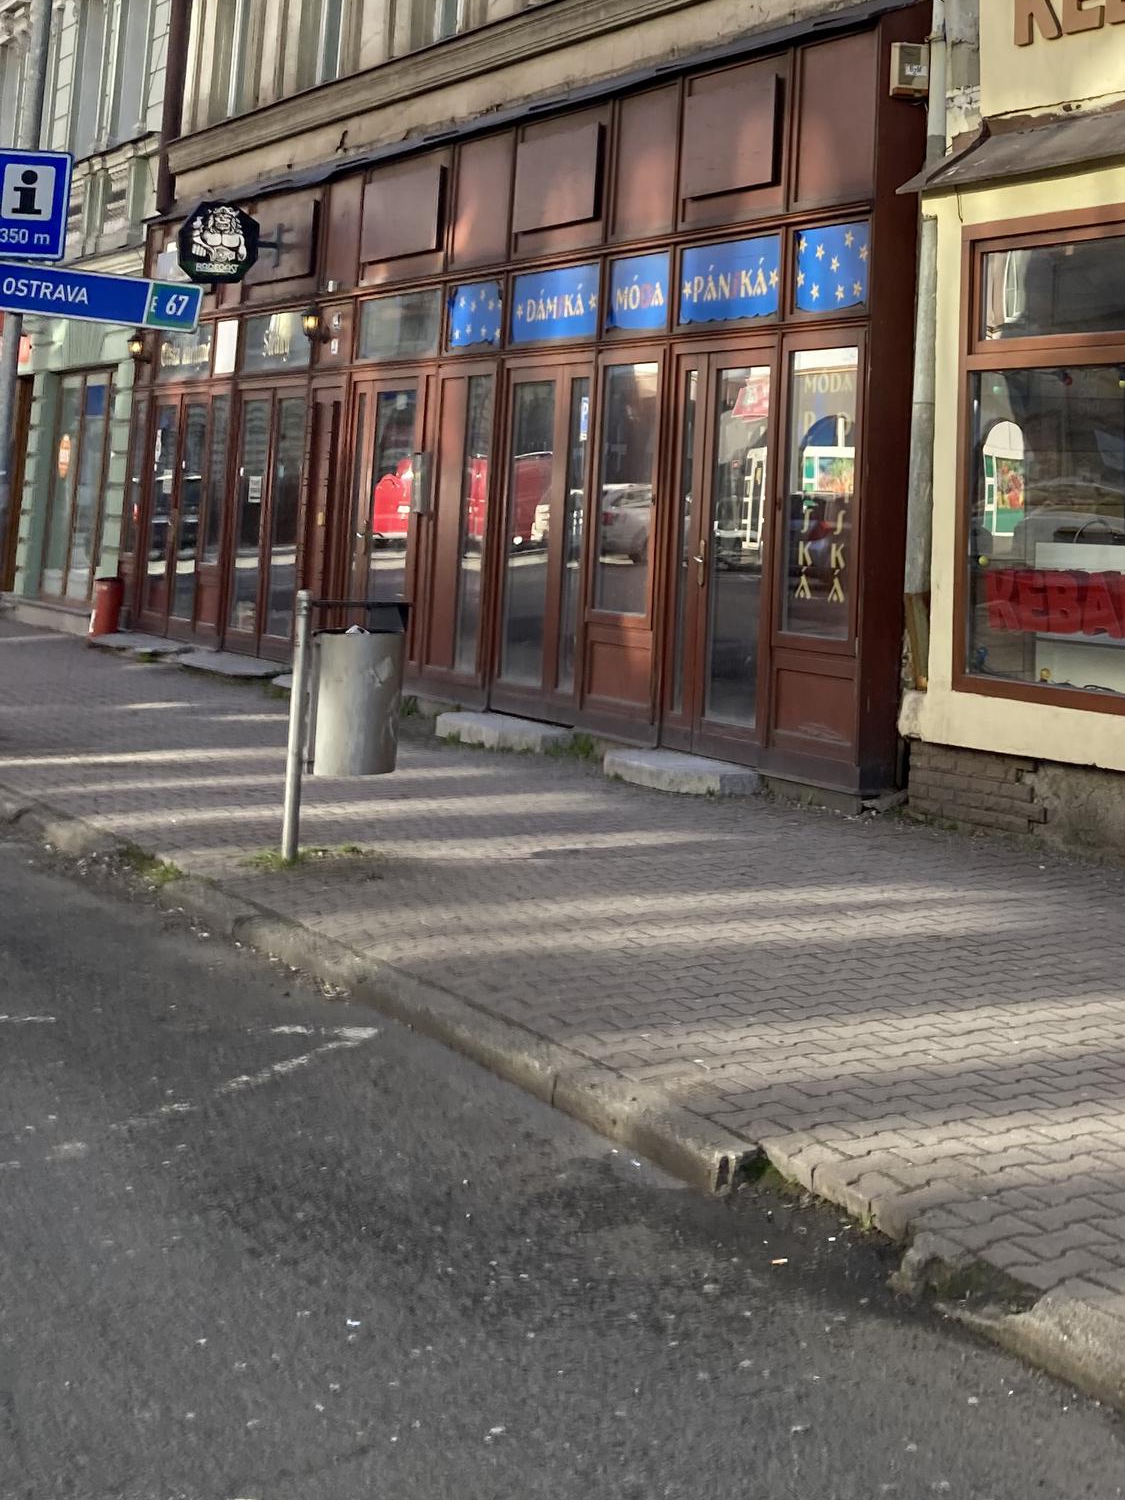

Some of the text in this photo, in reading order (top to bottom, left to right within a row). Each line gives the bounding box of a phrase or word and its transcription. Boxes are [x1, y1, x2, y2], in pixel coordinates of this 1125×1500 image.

[0, 227, 50, 245] 350 m
[2, 277, 89, 305] OSTRAVA
[165, 293, 190, 315] 67
